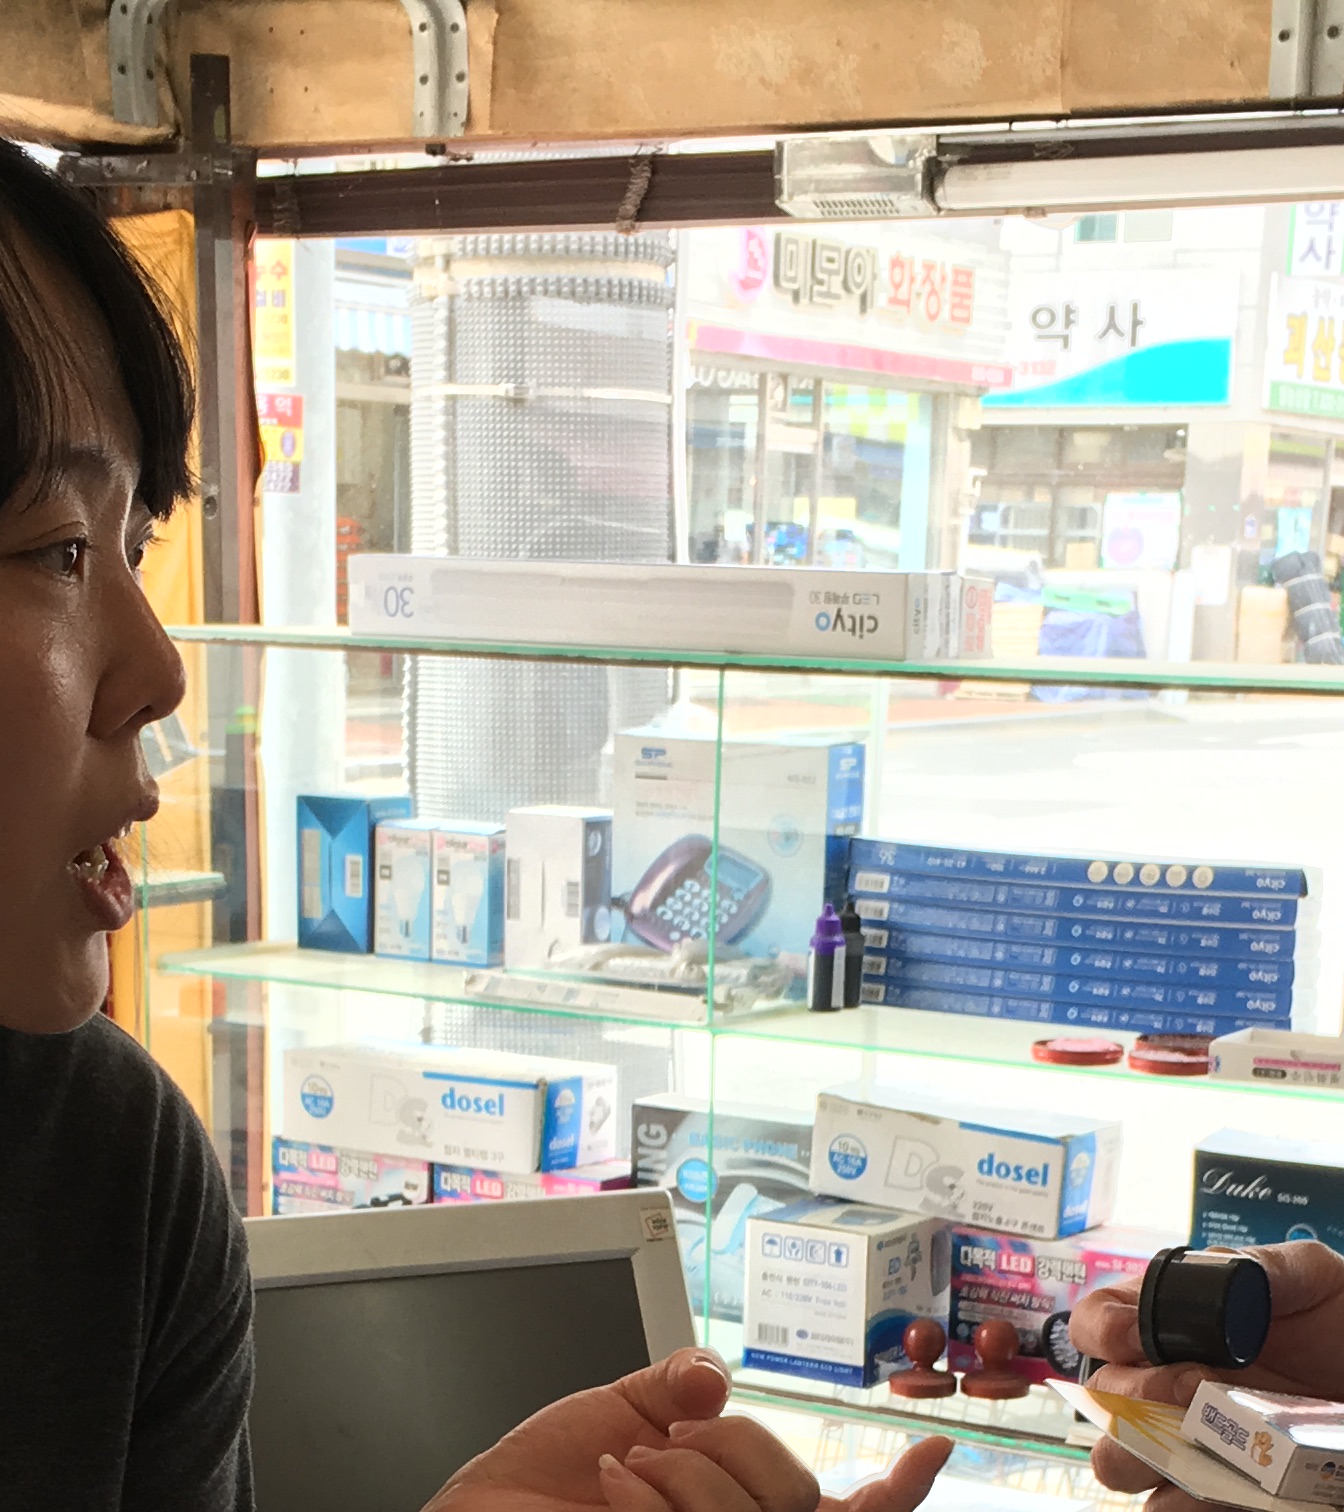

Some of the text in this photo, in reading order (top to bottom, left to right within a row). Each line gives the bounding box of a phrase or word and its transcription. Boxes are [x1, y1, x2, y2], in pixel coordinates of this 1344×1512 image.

[888, 254, 974, 327] 화장품
[383, 585, 415, 618] 30
[814, 611, 879, 637] cityo
[441, 1087, 506, 1118] dosel
[311, 1153, 337, 1172] LED
[977, 1152, 1049, 1188] dosel
[475, 1180, 502, 1198] LED
[1200, 1167, 1274, 1201] Duke
[960, 1245, 1087, 1285] 다목적 LED 강력랜턴
